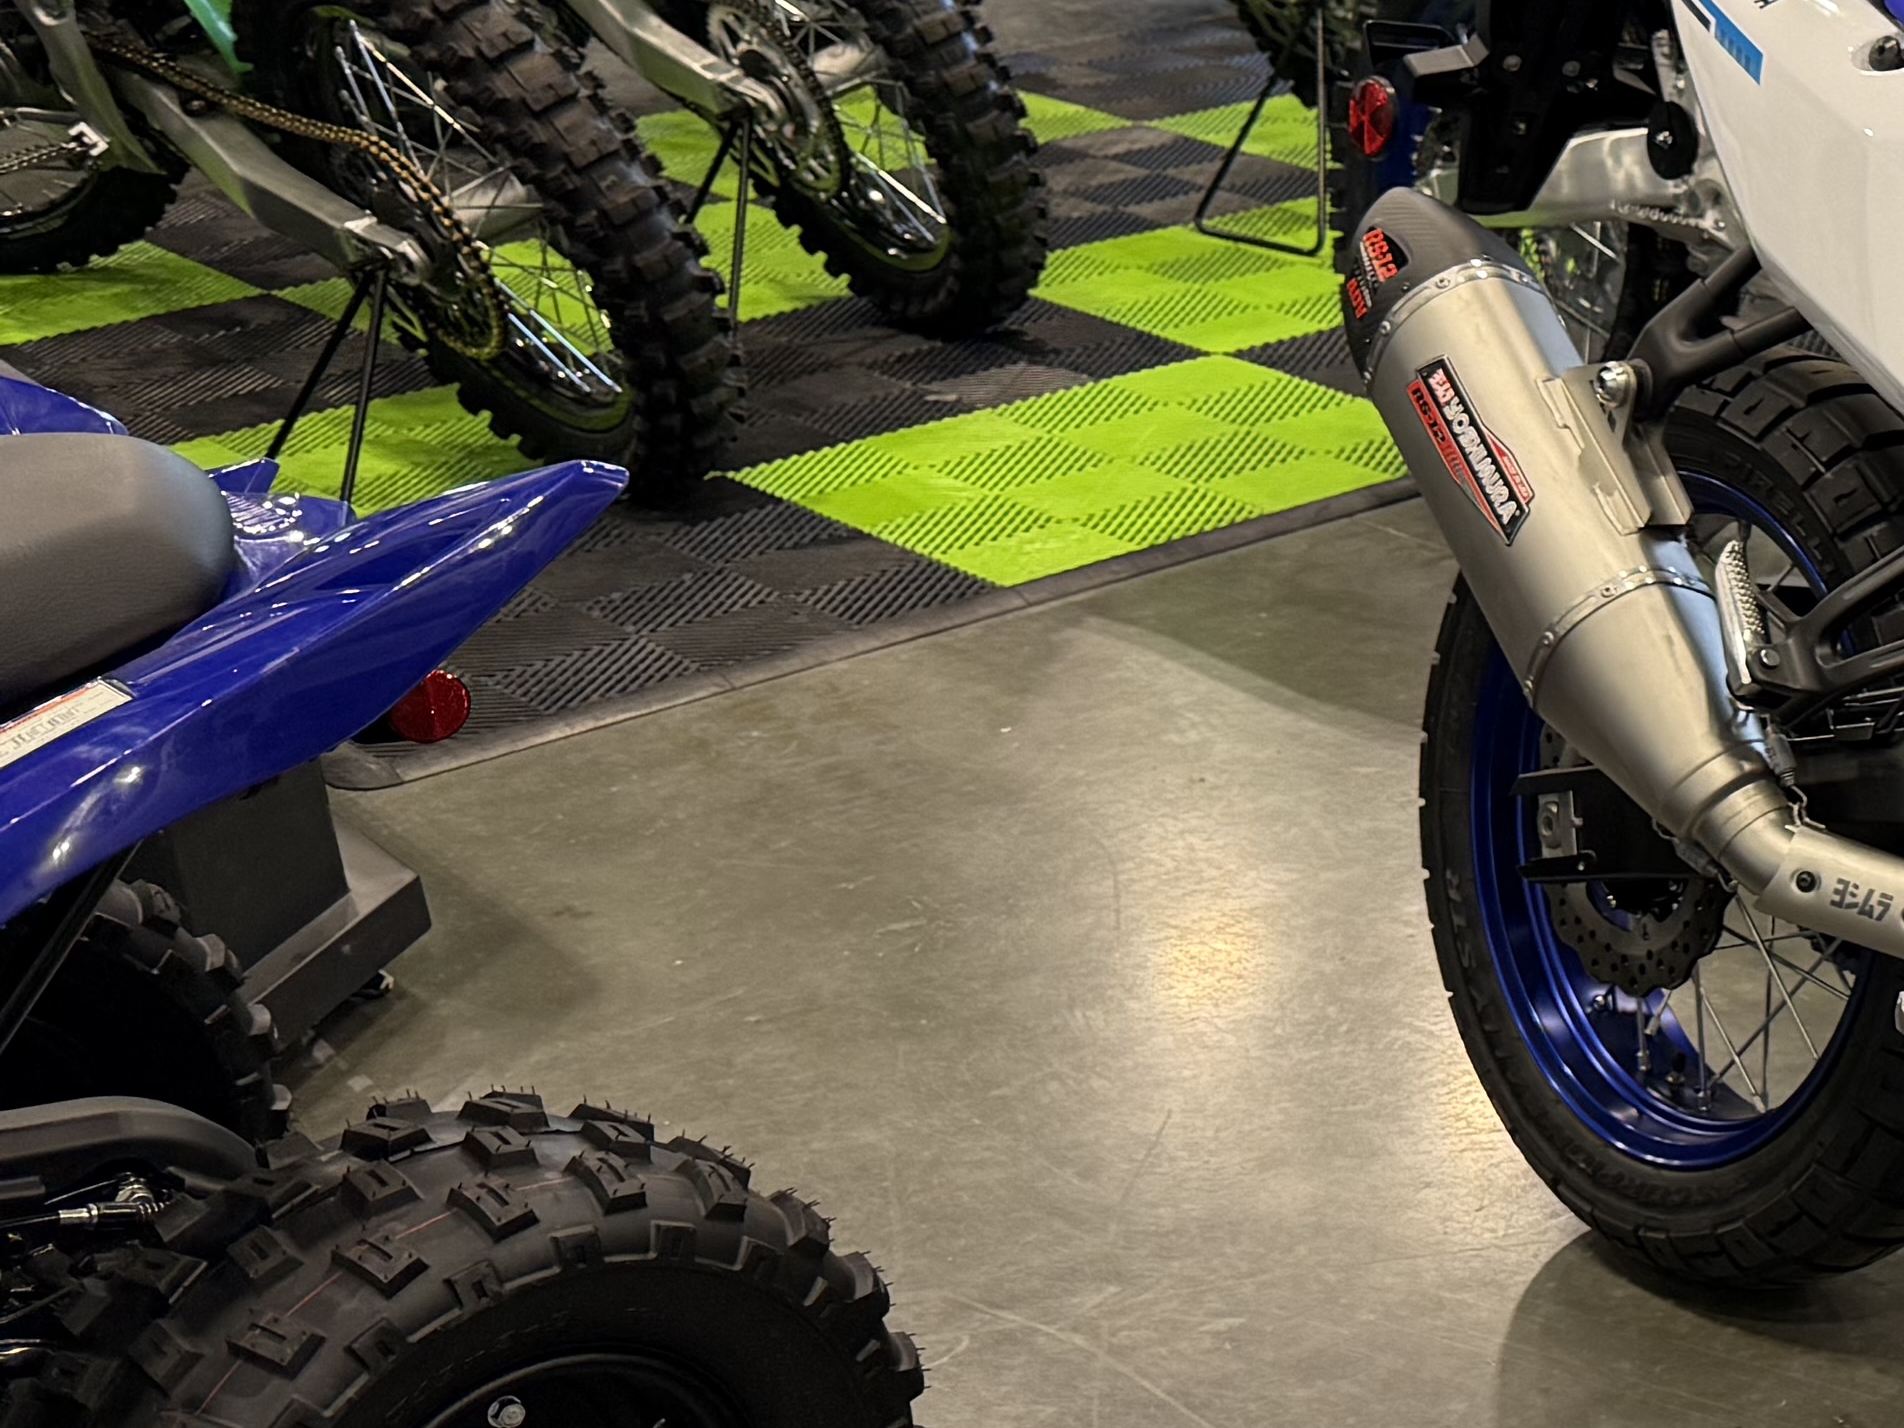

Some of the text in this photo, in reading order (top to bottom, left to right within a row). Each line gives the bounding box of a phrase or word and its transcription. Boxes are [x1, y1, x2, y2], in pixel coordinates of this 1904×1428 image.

[1442, 395, 1518, 527] YOSHIMURA
[1829, 877, 1895, 922] ヨシムラ
